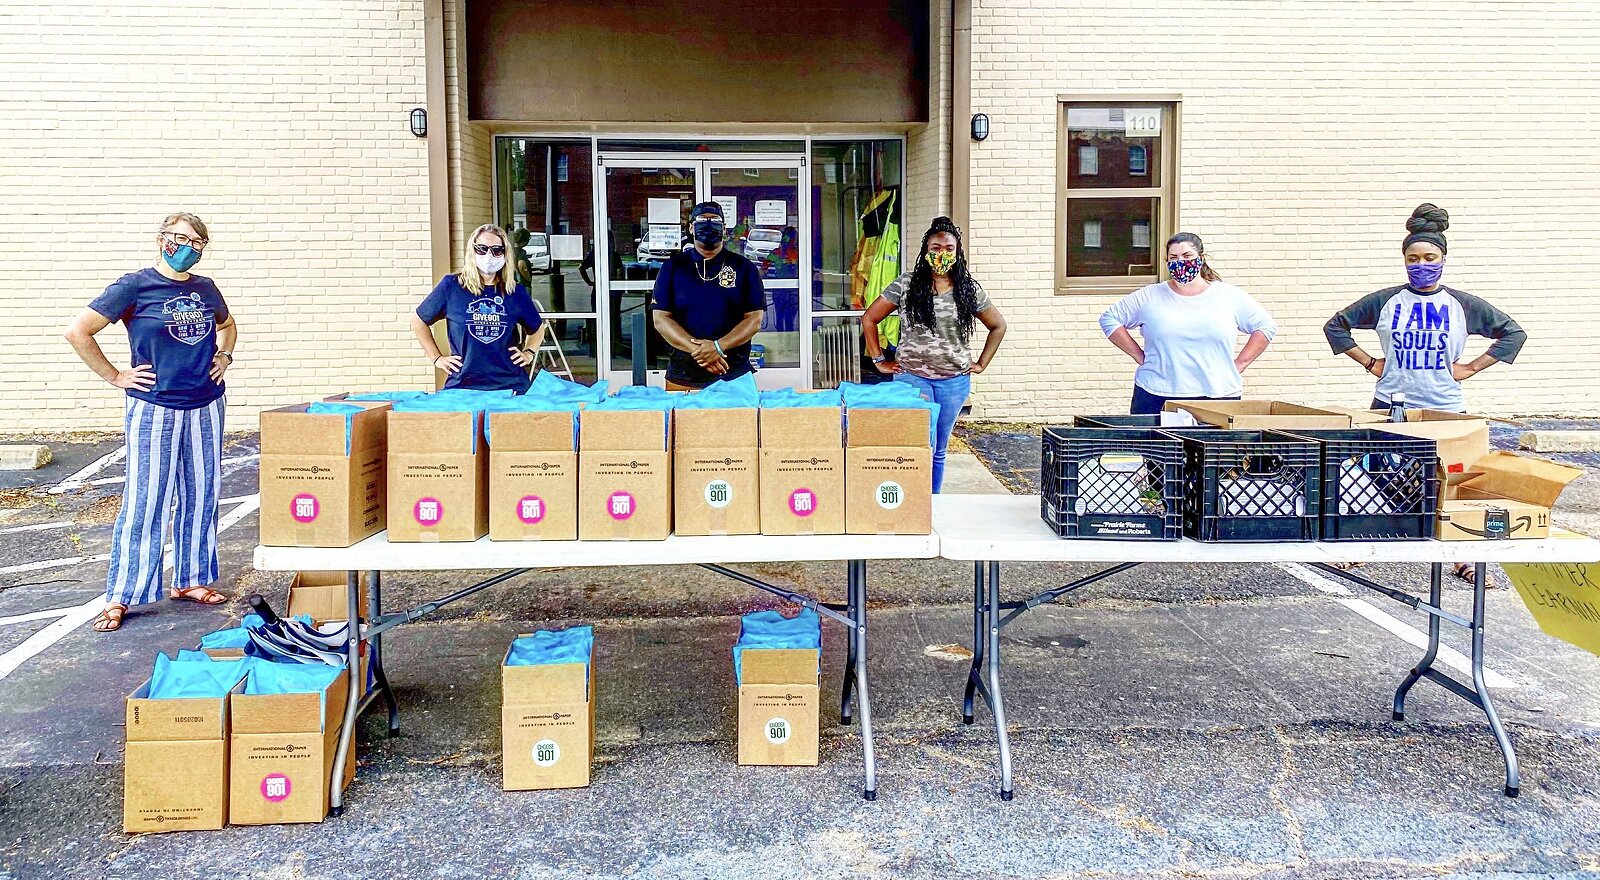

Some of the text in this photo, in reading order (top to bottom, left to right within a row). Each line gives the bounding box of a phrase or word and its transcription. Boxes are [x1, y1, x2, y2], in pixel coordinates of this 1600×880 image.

[1129, 116, 1157, 130] 110
[1391, 302, 1450, 331] I AM
[1391, 331, 1449, 351] SOULS
[1394, 350, 1446, 370] VILLE
[710, 490, 727, 502] 901
[881, 492, 898, 504] 901
[296, 505, 315, 518] 901
[612, 502, 631, 515] 901
[794, 499, 812, 511] 901
[419, 508, 438, 521] 901
[522, 506, 541, 519] 901
[1486, 519, 1505, 528] prime
[770, 728, 786, 739] 901
[538, 750, 554, 762] 901
[267, 784, 286, 797] 901
